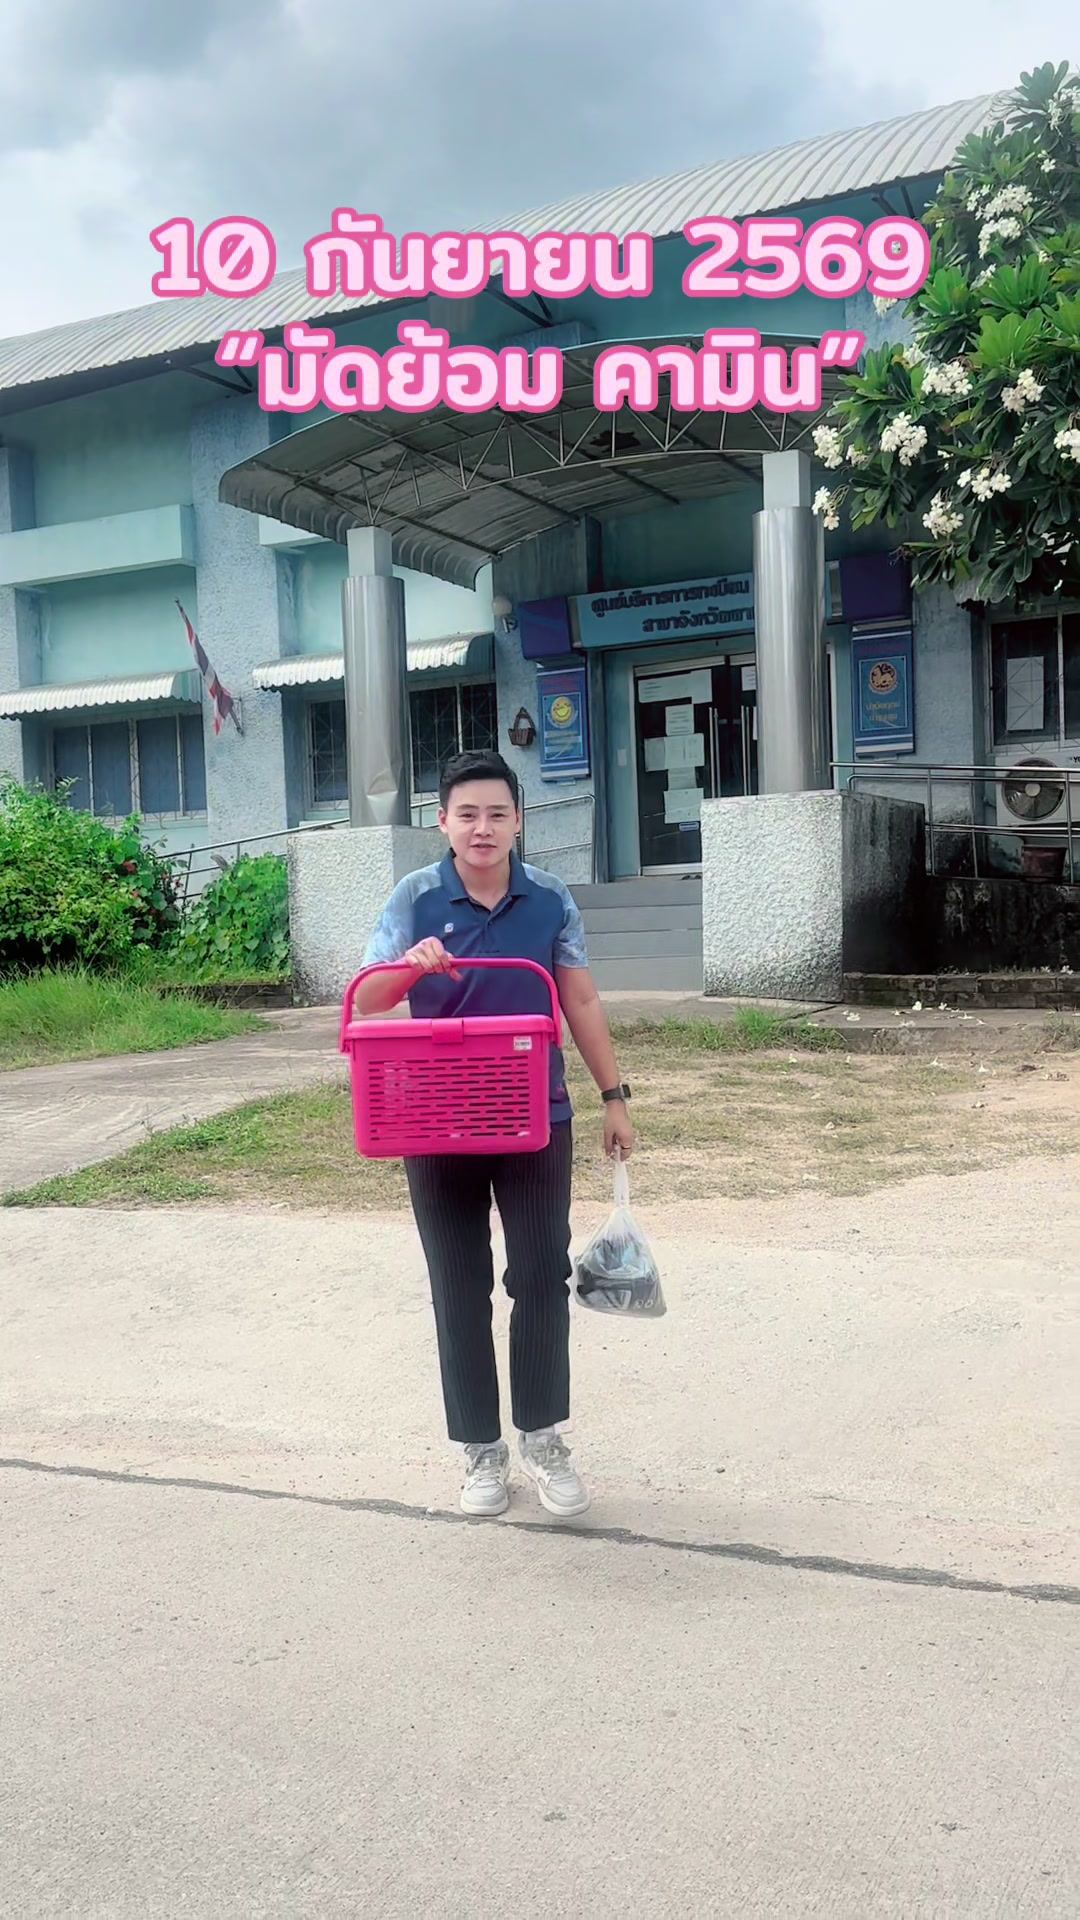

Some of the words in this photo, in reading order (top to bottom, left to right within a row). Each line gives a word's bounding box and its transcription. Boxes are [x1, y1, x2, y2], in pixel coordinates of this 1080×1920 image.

[642, 606, 755, 632] สาขาจังหวัดตา
